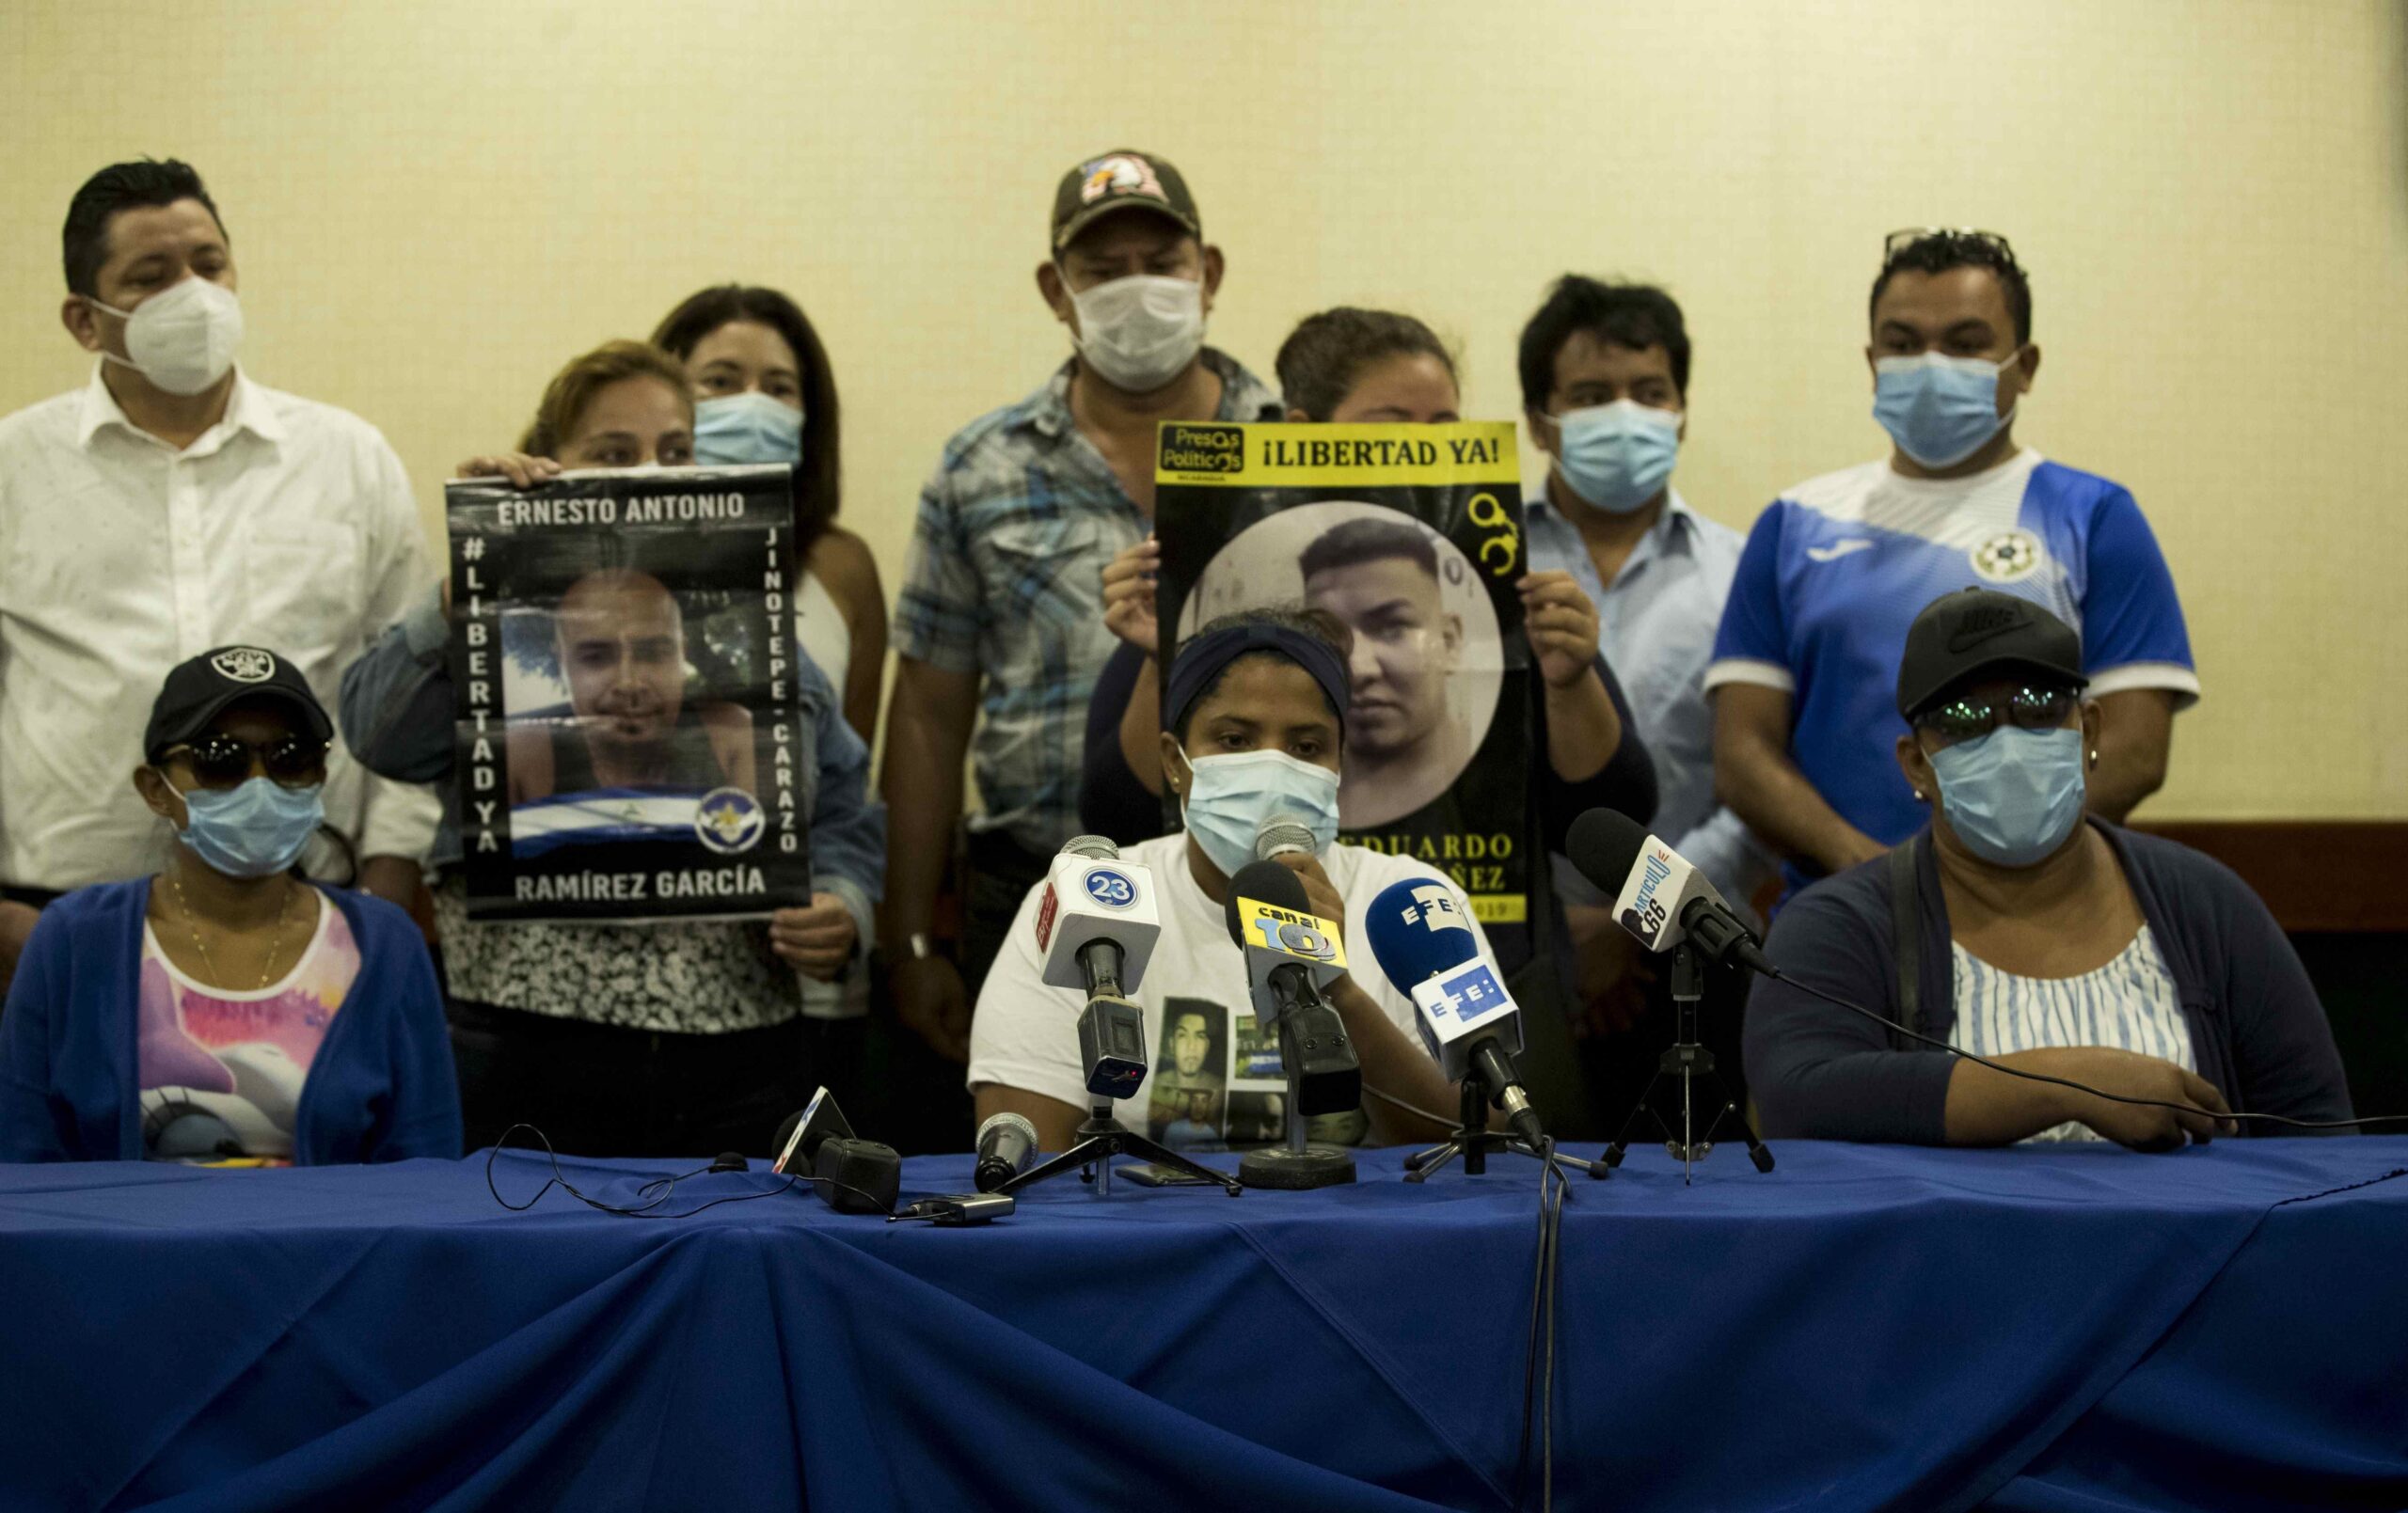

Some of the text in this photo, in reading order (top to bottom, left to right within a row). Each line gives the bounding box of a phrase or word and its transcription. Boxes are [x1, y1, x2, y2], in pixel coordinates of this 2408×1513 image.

[1263, 438, 1498, 466] ¡LIBERTAD YA!
[498, 492, 744, 527] ERNESTO ANTONIO
[515, 863, 767, 901] RAMÍREZ GARCÍA
[1091, 875, 1131, 900] 23
[1259, 906, 1321, 930] canal
[1643, 898, 1667, 932] 66
[1254, 919, 1337, 961] 10
